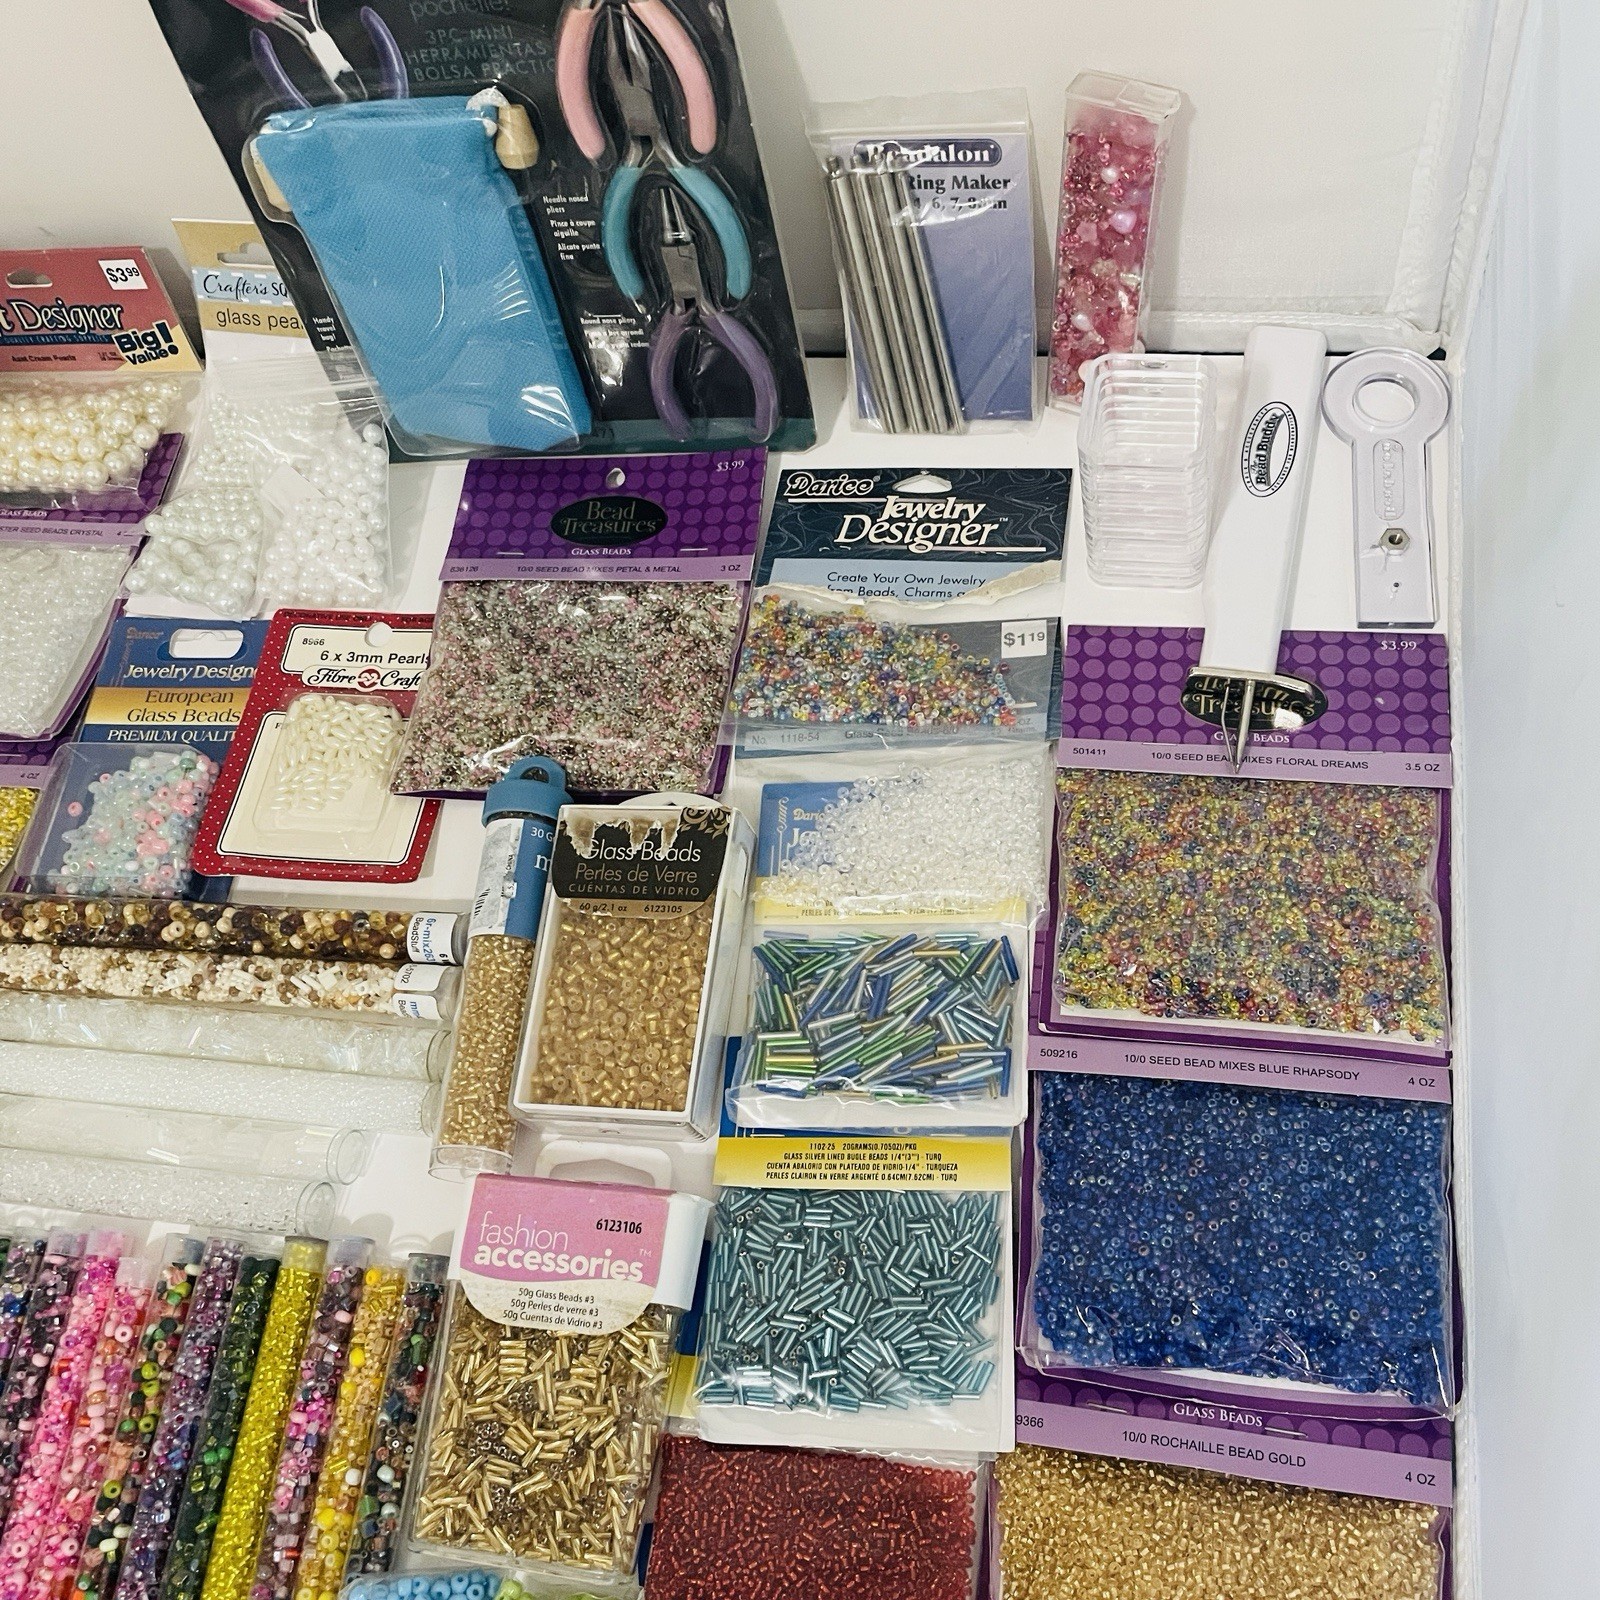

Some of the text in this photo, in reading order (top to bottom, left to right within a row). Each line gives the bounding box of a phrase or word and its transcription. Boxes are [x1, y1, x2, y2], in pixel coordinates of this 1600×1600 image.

[426, 25, 513, 44] 3PC MINI
[405, 41, 547, 64] HERRAMIENTAS
[414, 66, 475, 82] BOLSA
[951, 174, 1011, 190] Maker
[543, 193, 589, 204] Needle nosed
[546, 206, 566, 215] pliers
[550, 219, 569, 227] Pince
[203, 274, 269, 301] Crafter's
[11, 298, 123, 335] Designer
[216, 308, 261, 327] glass
[113, 320, 179, 356] Big!
[126, 349, 168, 365] Value
[1255, 412, 1280, 485] Bead Buddy
[716, 459, 745, 472] $3.99
[784, 472, 875, 496] Darice
[587, 500, 636, 520] Bead
[877, 495, 987, 526] Jewelry
[42, 527, 69, 535] BEADS
[70, 528, 103, 537] CRYSTAL
[561, 518, 656, 536] Treasures
[834, 514, 999, 553] Designer
[571, 547, 632, 556] GLASS BEADS
[728, 564, 741, 572] OZ
[827, 571, 987, 588] Create Your Own Jewelry
[858, 586, 952, 598] Beads, Charms
[1380, 640, 1417, 652] $3.99
[320, 650, 329, 661] 6
[333, 652, 342, 662] x
[346, 651, 383, 664] 3mm
[124, 664, 193, 682] Jewelry
[308, 668, 424, 689] Fibre Craft
[145, 690, 234, 706] European
[128, 708, 242, 723] Glass Beads
[107, 729, 178, 741] PREMIUM
[780, 732, 820, 744] 1118-54
[1253, 732, 1290, 743] BEADS
[1073, 747, 1106, 756] 501411
[1151, 752, 1171, 760] 10/0
[1174, 753, 1203, 761] SEED
[1242, 755, 1273, 764] MIXES
[1276, 757, 1318, 767] FLORAL
[1321, 759, 1369, 769] DREAMS
[1405, 762, 1422, 771] 3.5
[1424, 763, 1441, 772] OZ
[530, 826, 544, 838] 30
[583, 838, 701, 862] Glass Beads
[575, 863, 698, 883] Perles de Verre
[632, 886, 700, 896] DE VIDRIO
[579, 902, 591, 910] 60
[643, 905, 683, 914] 6123105
[1040, 1048, 1436, 1088] 509216 10/0 SEED BEAD MIXES BLUE RHAPSODY 4 OZ
[804, 1153, 825, 1161] SILVER
[868, 1153, 888, 1161] BEADS
[925, 1153, 942, 1162] TURQ
[766, 1162, 791, 1170] CUENTA
[839, 1163, 871, 1171] PLATEADO
[926, 1163, 958, 1172] TURQUEZA
[766, 1172, 789, 1180] PERLES
[790, 1172, 817, 1180] CLAIRON
[941, 1174, 958, 1182] TURQ
[479, 1210, 569, 1252] fashion
[596, 1218, 642, 1235] 6123106
[473, 1244, 644, 1282] accessories
[518, 1287, 595, 1304] 50g Glass Beads #3
[511, 1298, 599, 1317] 50g Perles de verre #3
[503, 1309, 603, 1330] 50g Cuentas de Vidrio #3
[1173, 1402, 1263, 1427] GLASS BEADS
[1122, 1430, 1147, 1444] 10/0
[1150, 1434, 1225, 1456] ROCHAILLE
[1228, 1445, 1264, 1461] BEAD
[1268, 1452, 1306, 1468] GOLD
[1404, 1471, 1412, 1482] 4
[1415, 1472, 1436, 1486] OZ
